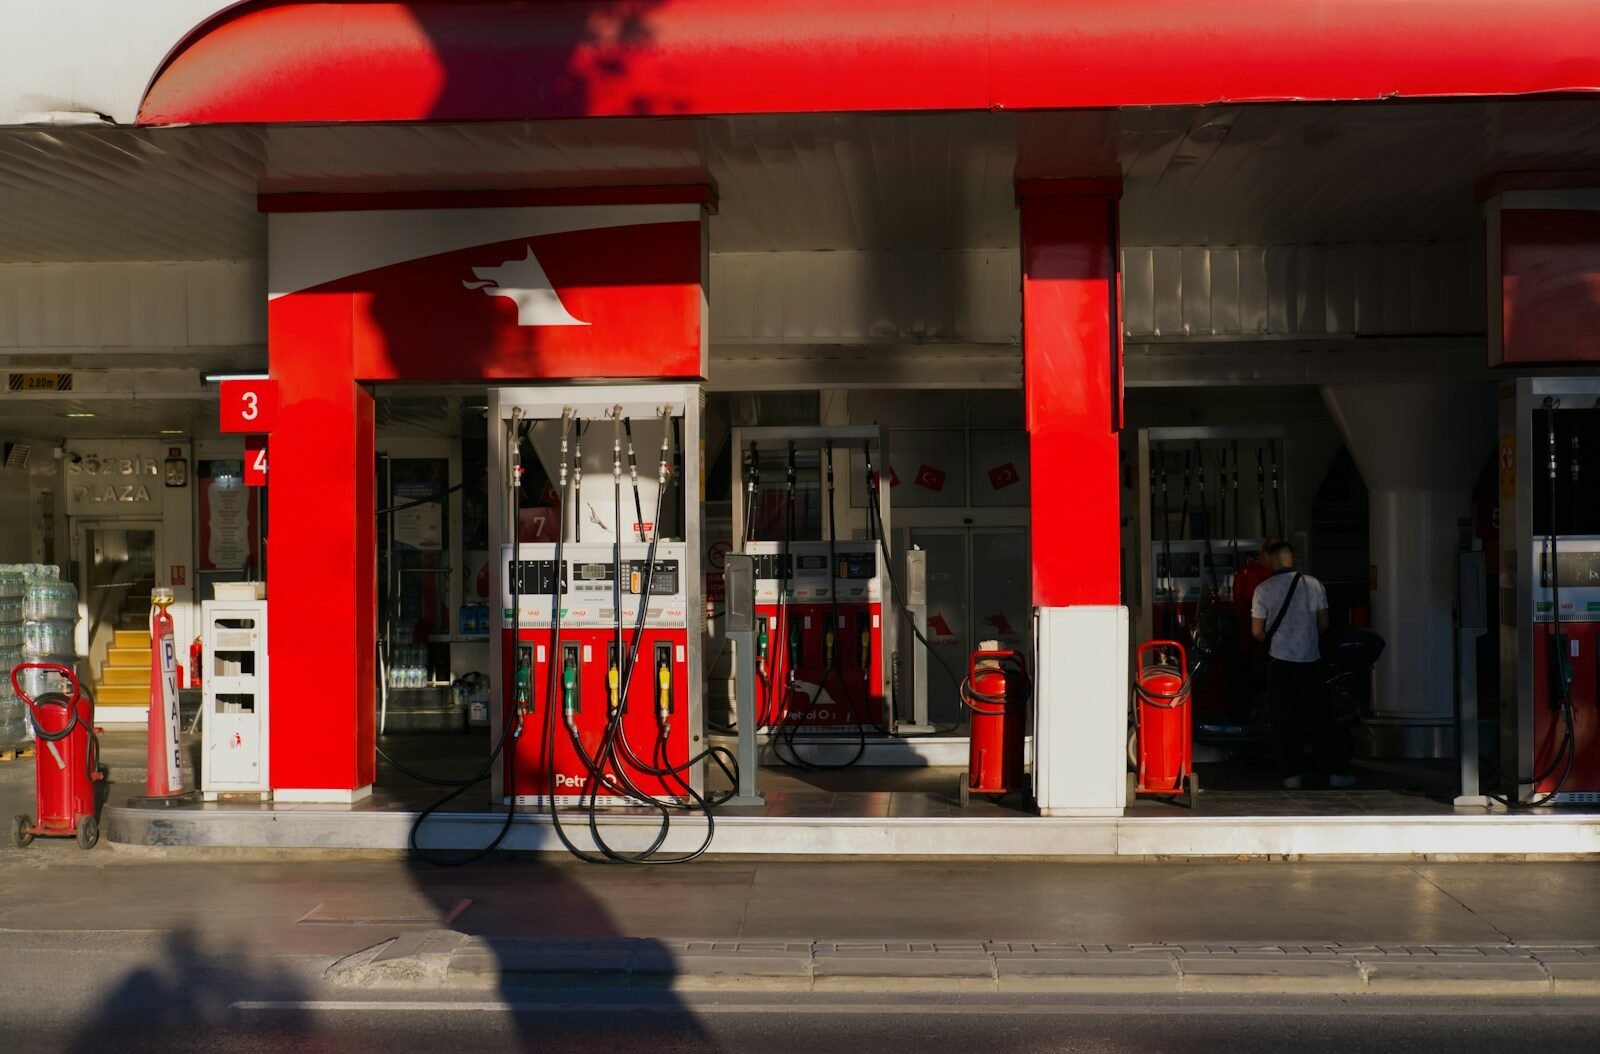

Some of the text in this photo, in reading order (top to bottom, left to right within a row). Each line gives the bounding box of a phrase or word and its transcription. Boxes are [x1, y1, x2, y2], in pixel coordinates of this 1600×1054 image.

[28, 377, 54, 388] 2.80m
[241, 391, 258, 420] 3
[68, 453, 159, 476] SÖZBİR
[253, 448, 268, 475] 4
[73, 485, 152, 503] PLAZA
[533, 516, 546, 537] 7
[165, 643, 173, 669] P
[168, 676, 181, 769] VALE
[555, 773, 597, 788] Petr
